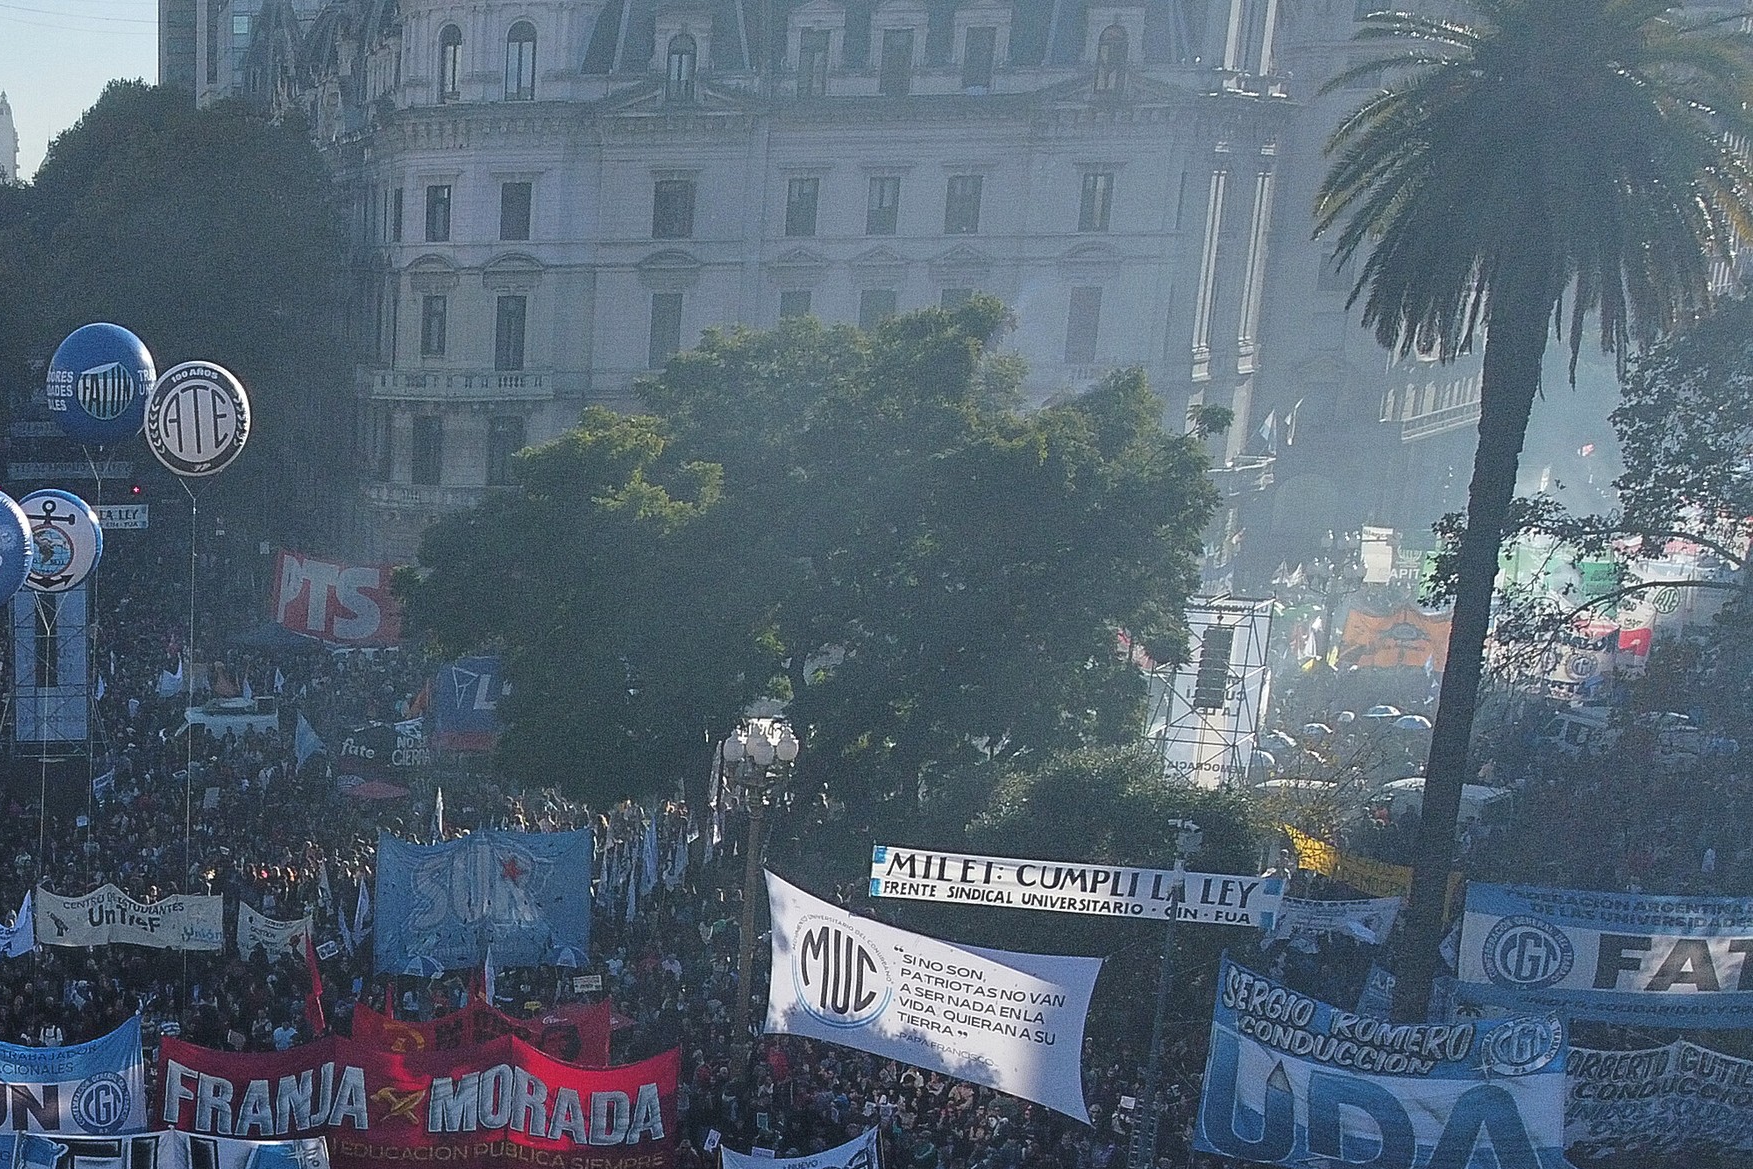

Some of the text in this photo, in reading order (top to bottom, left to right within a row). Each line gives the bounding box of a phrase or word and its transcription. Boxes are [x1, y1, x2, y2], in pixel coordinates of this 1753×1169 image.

[171, 368, 219, 384] 100 AÑOS
[165, 384, 229, 454] ATE
[277, 554, 382, 640] PTS
[62, 893, 105, 910] CENTRO
[883, 880, 937, 898] FRENTE
[947, 884, 1013, 905] SINDICAL
[1021, 891, 1144, 917] UNIVERSITARIO
[1215, 909, 1251, 925] FUA
[886, 851, 1259, 910] MILEI: CUMPLI LA LEY
[1631, 899, 1744, 915] ARGENTINA
[854, 928, 868, 943] DEL
[800, 926, 878, 1015] MUC
[900, 968, 1066, 1009] PATRIOTAS NO VAN
[918, 959, 944, 973] NO
[898, 996, 1056, 1047] VIDA QUIERAN A SU
[899, 982, 1045, 1025] A SER NADA EN LA
[1223, 965, 1316, 1028] SERGIO
[1331, 1007, 1475, 1062] ROMERO
[161, 1058, 370, 1137] FRANJA
[426, 1062, 666, 1149] MORADA
[344, 1140, 469, 1164] EDUCACION
